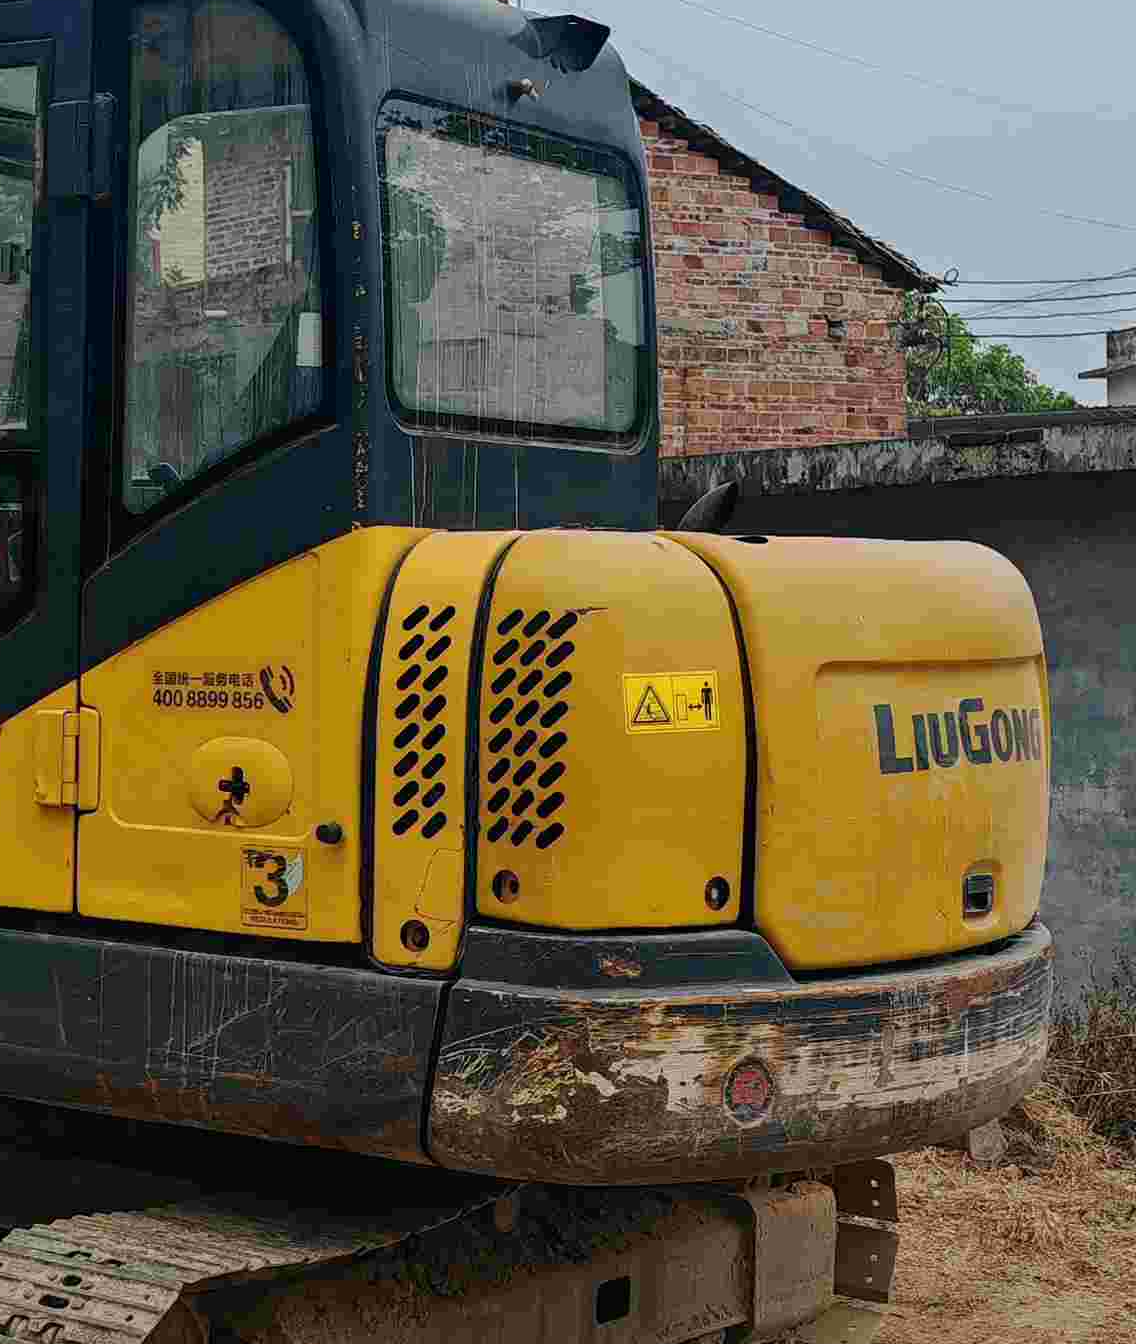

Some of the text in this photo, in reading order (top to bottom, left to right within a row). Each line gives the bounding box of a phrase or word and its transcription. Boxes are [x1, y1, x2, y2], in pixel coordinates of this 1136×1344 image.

[153, 689, 265, 710] 400 8899 856
[255, 855, 289, 908] 3
